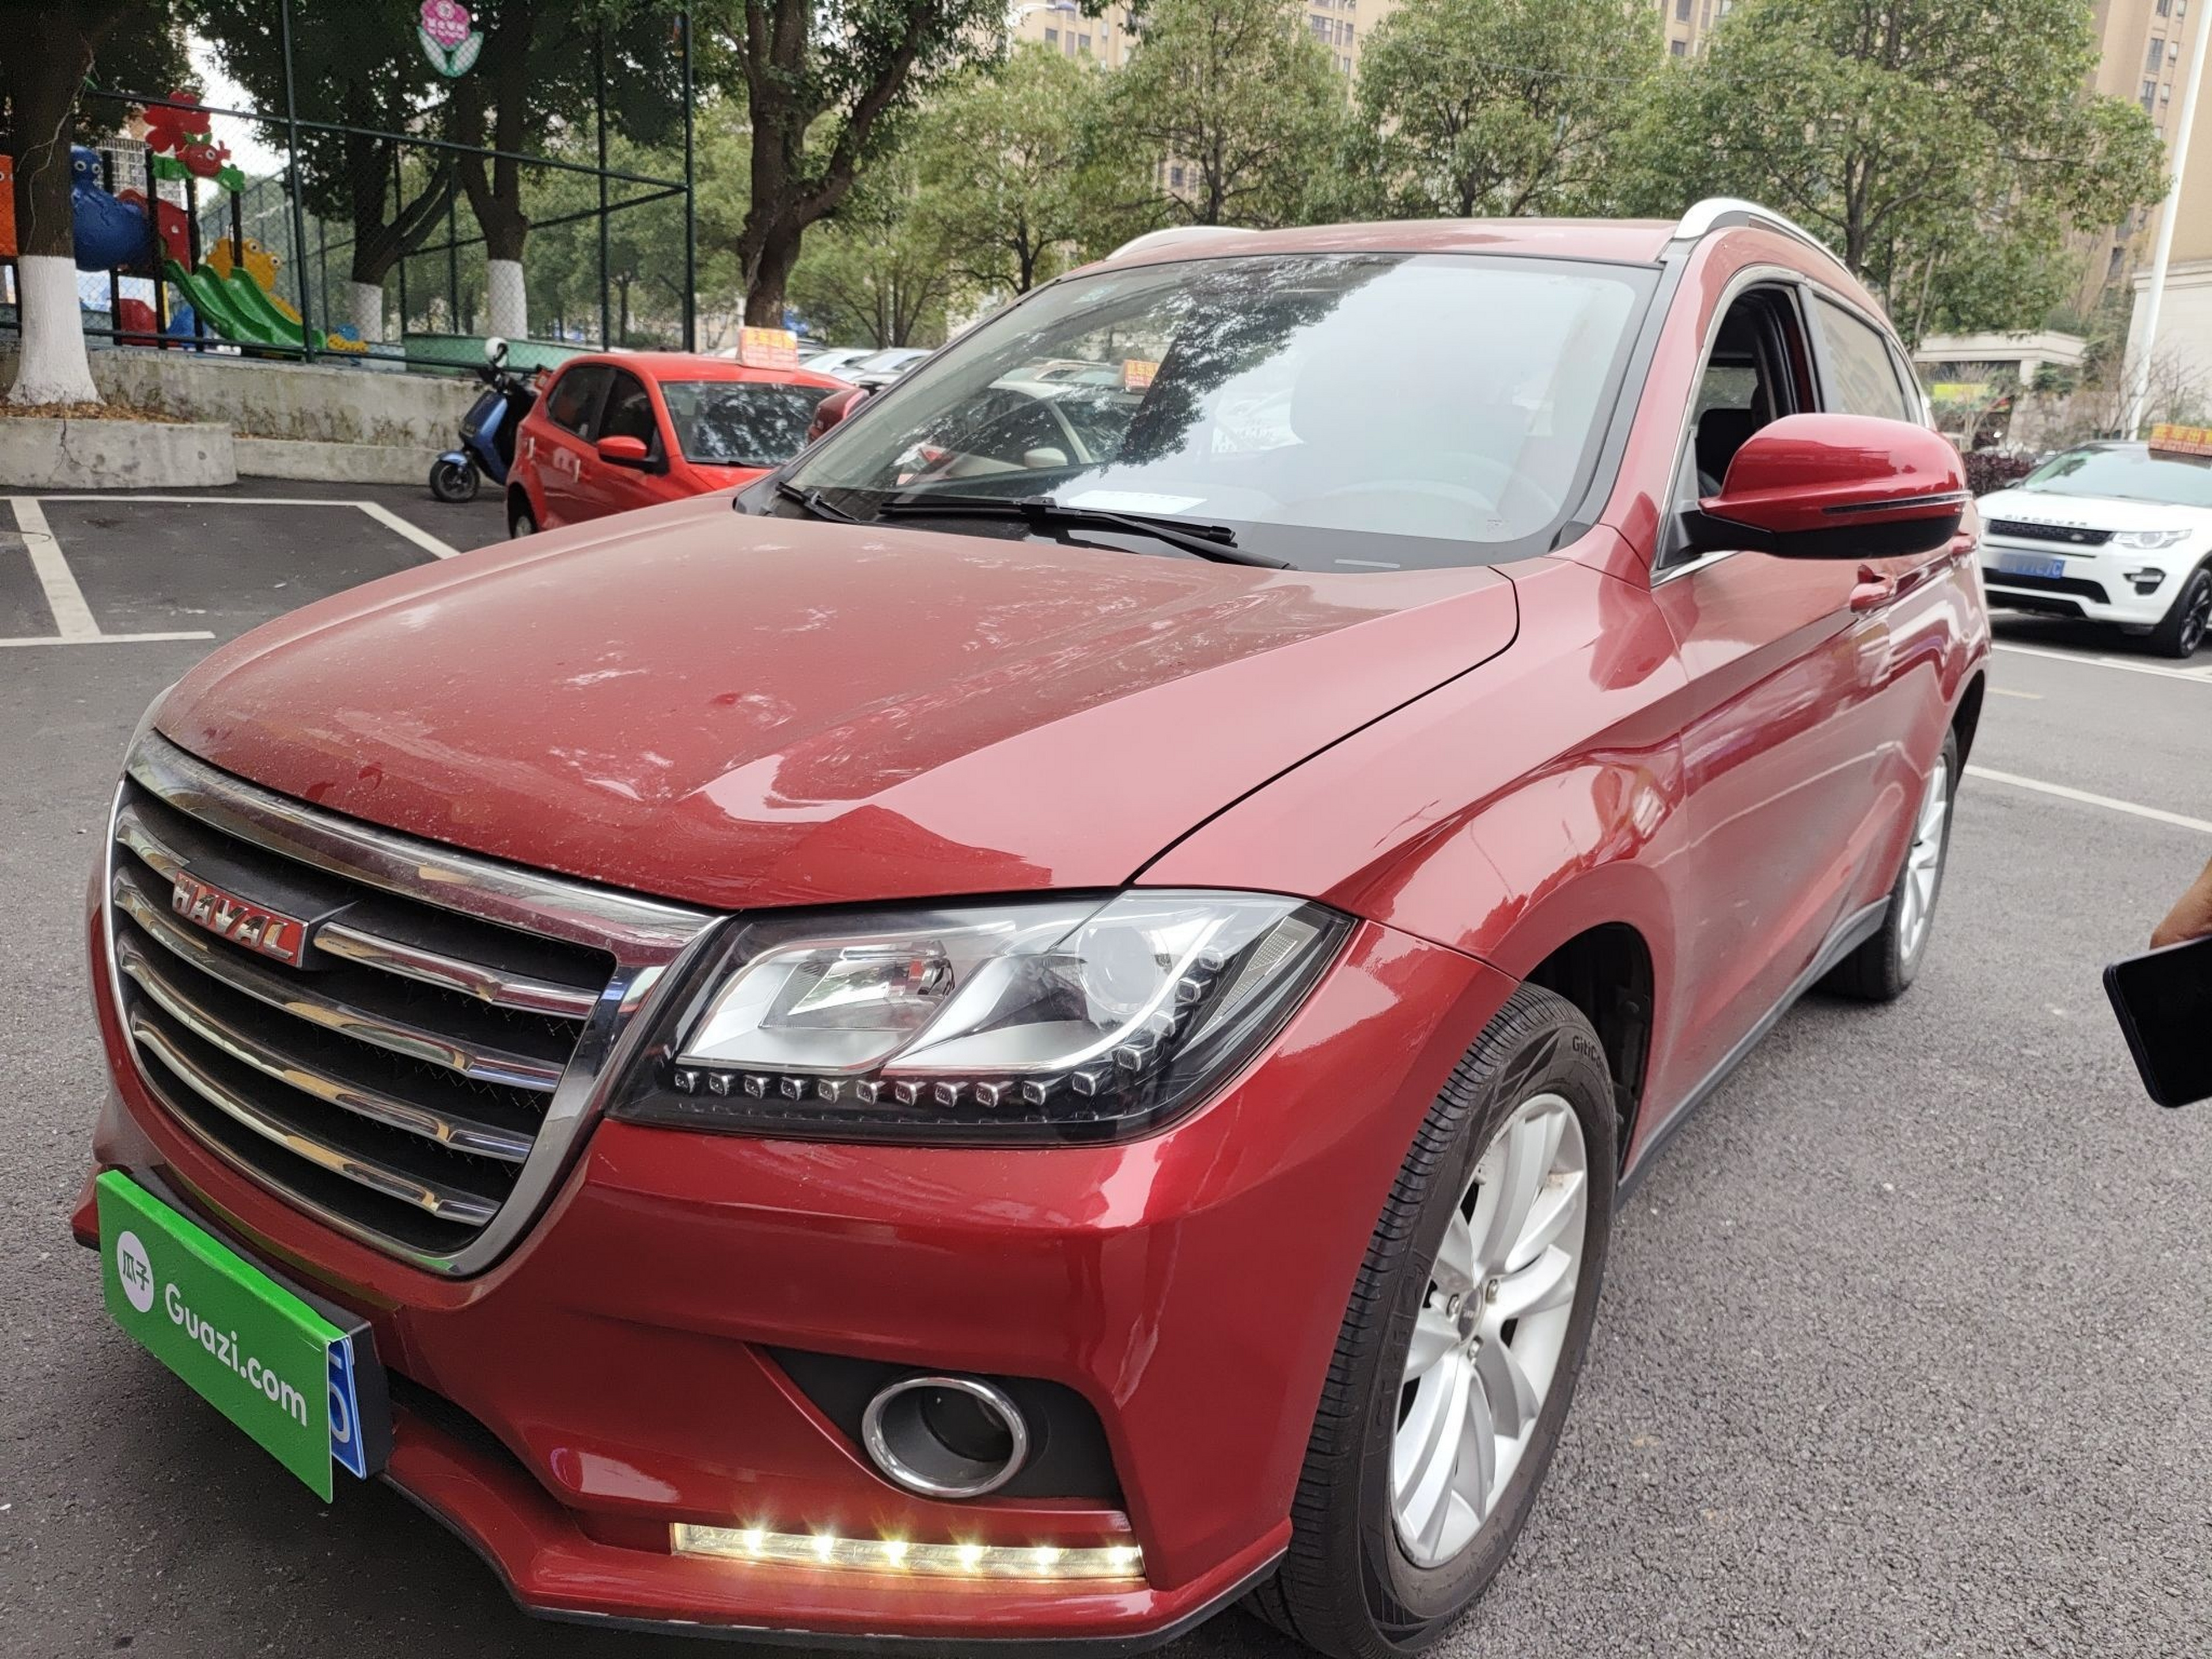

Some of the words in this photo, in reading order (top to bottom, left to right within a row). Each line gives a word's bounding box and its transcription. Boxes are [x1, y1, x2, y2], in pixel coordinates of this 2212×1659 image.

[173, 877, 293, 960] HAVAL
[122, 1251, 150, 1290] 瓜子
[165, 1283, 307, 1426] Guazi.com
